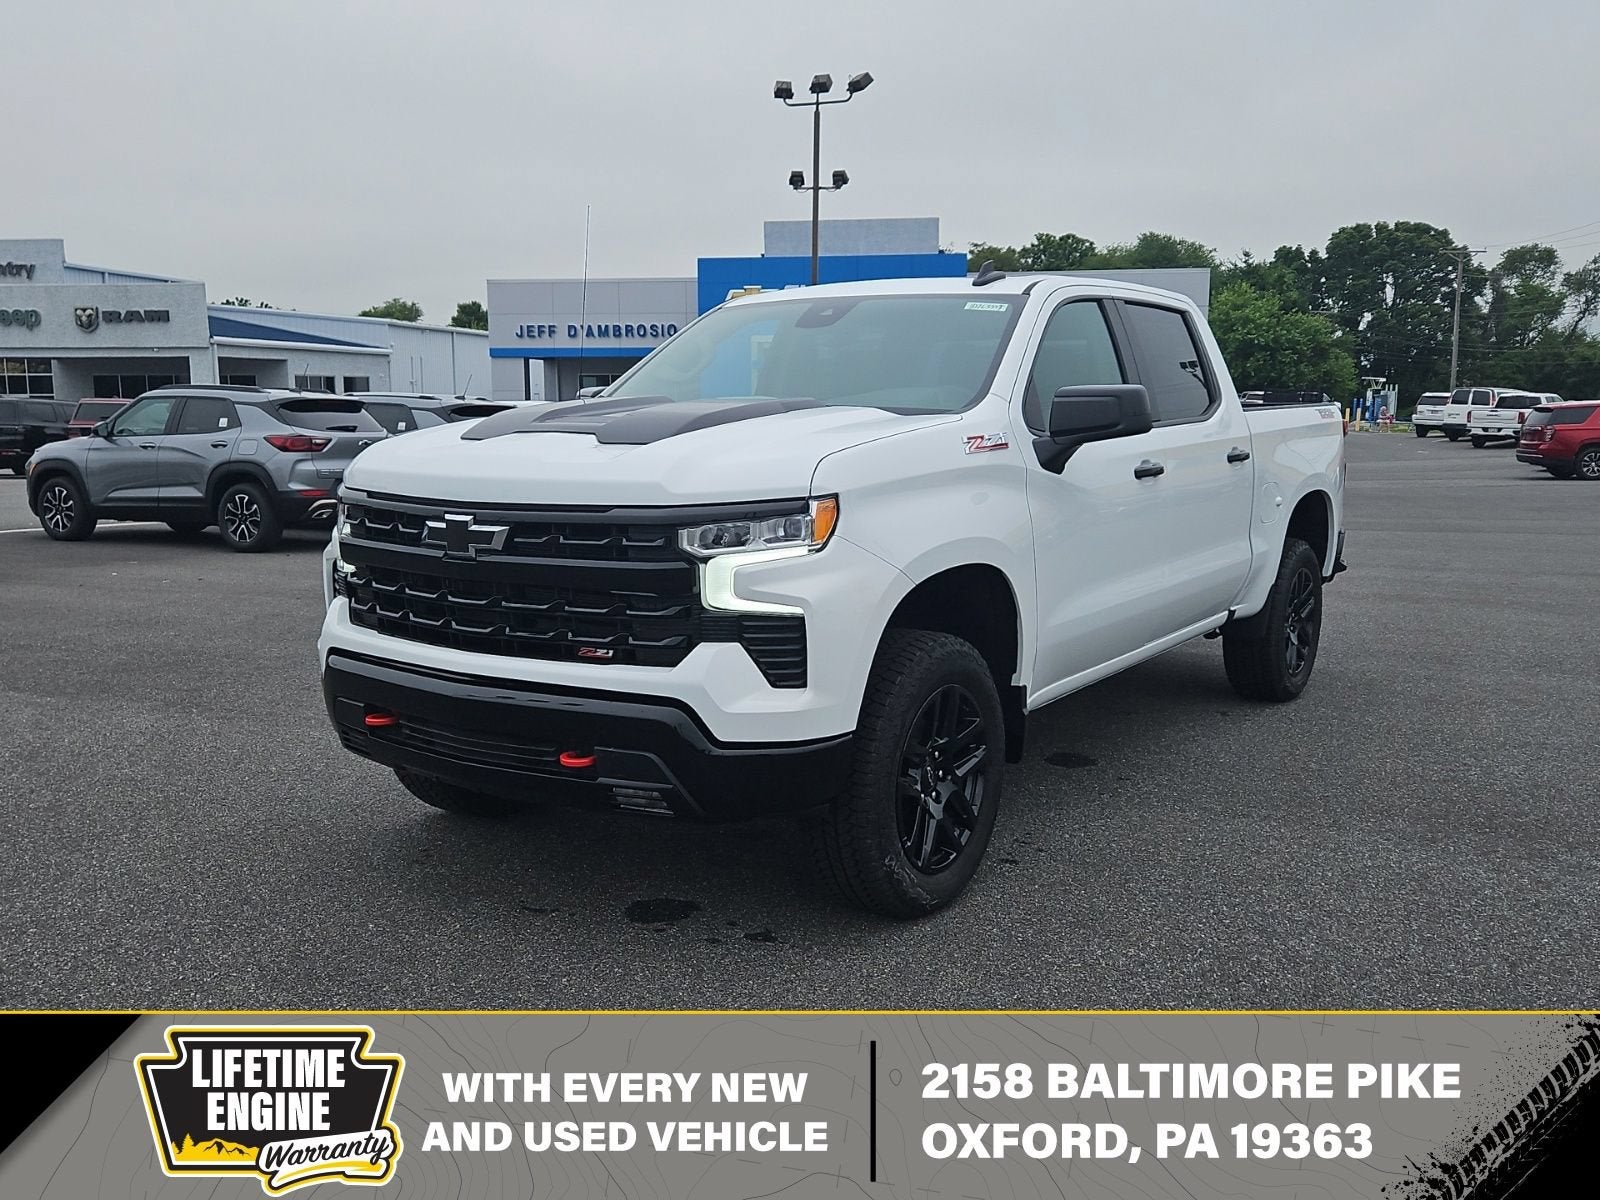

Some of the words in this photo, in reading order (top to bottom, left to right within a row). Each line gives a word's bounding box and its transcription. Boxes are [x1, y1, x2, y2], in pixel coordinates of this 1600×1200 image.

[102, 309, 170, 323] RAM
[515, 324, 557, 339] JEFF
[567, 323, 678, 339] D'AMBROSIO
[578, 646, 614, 658] Z71
